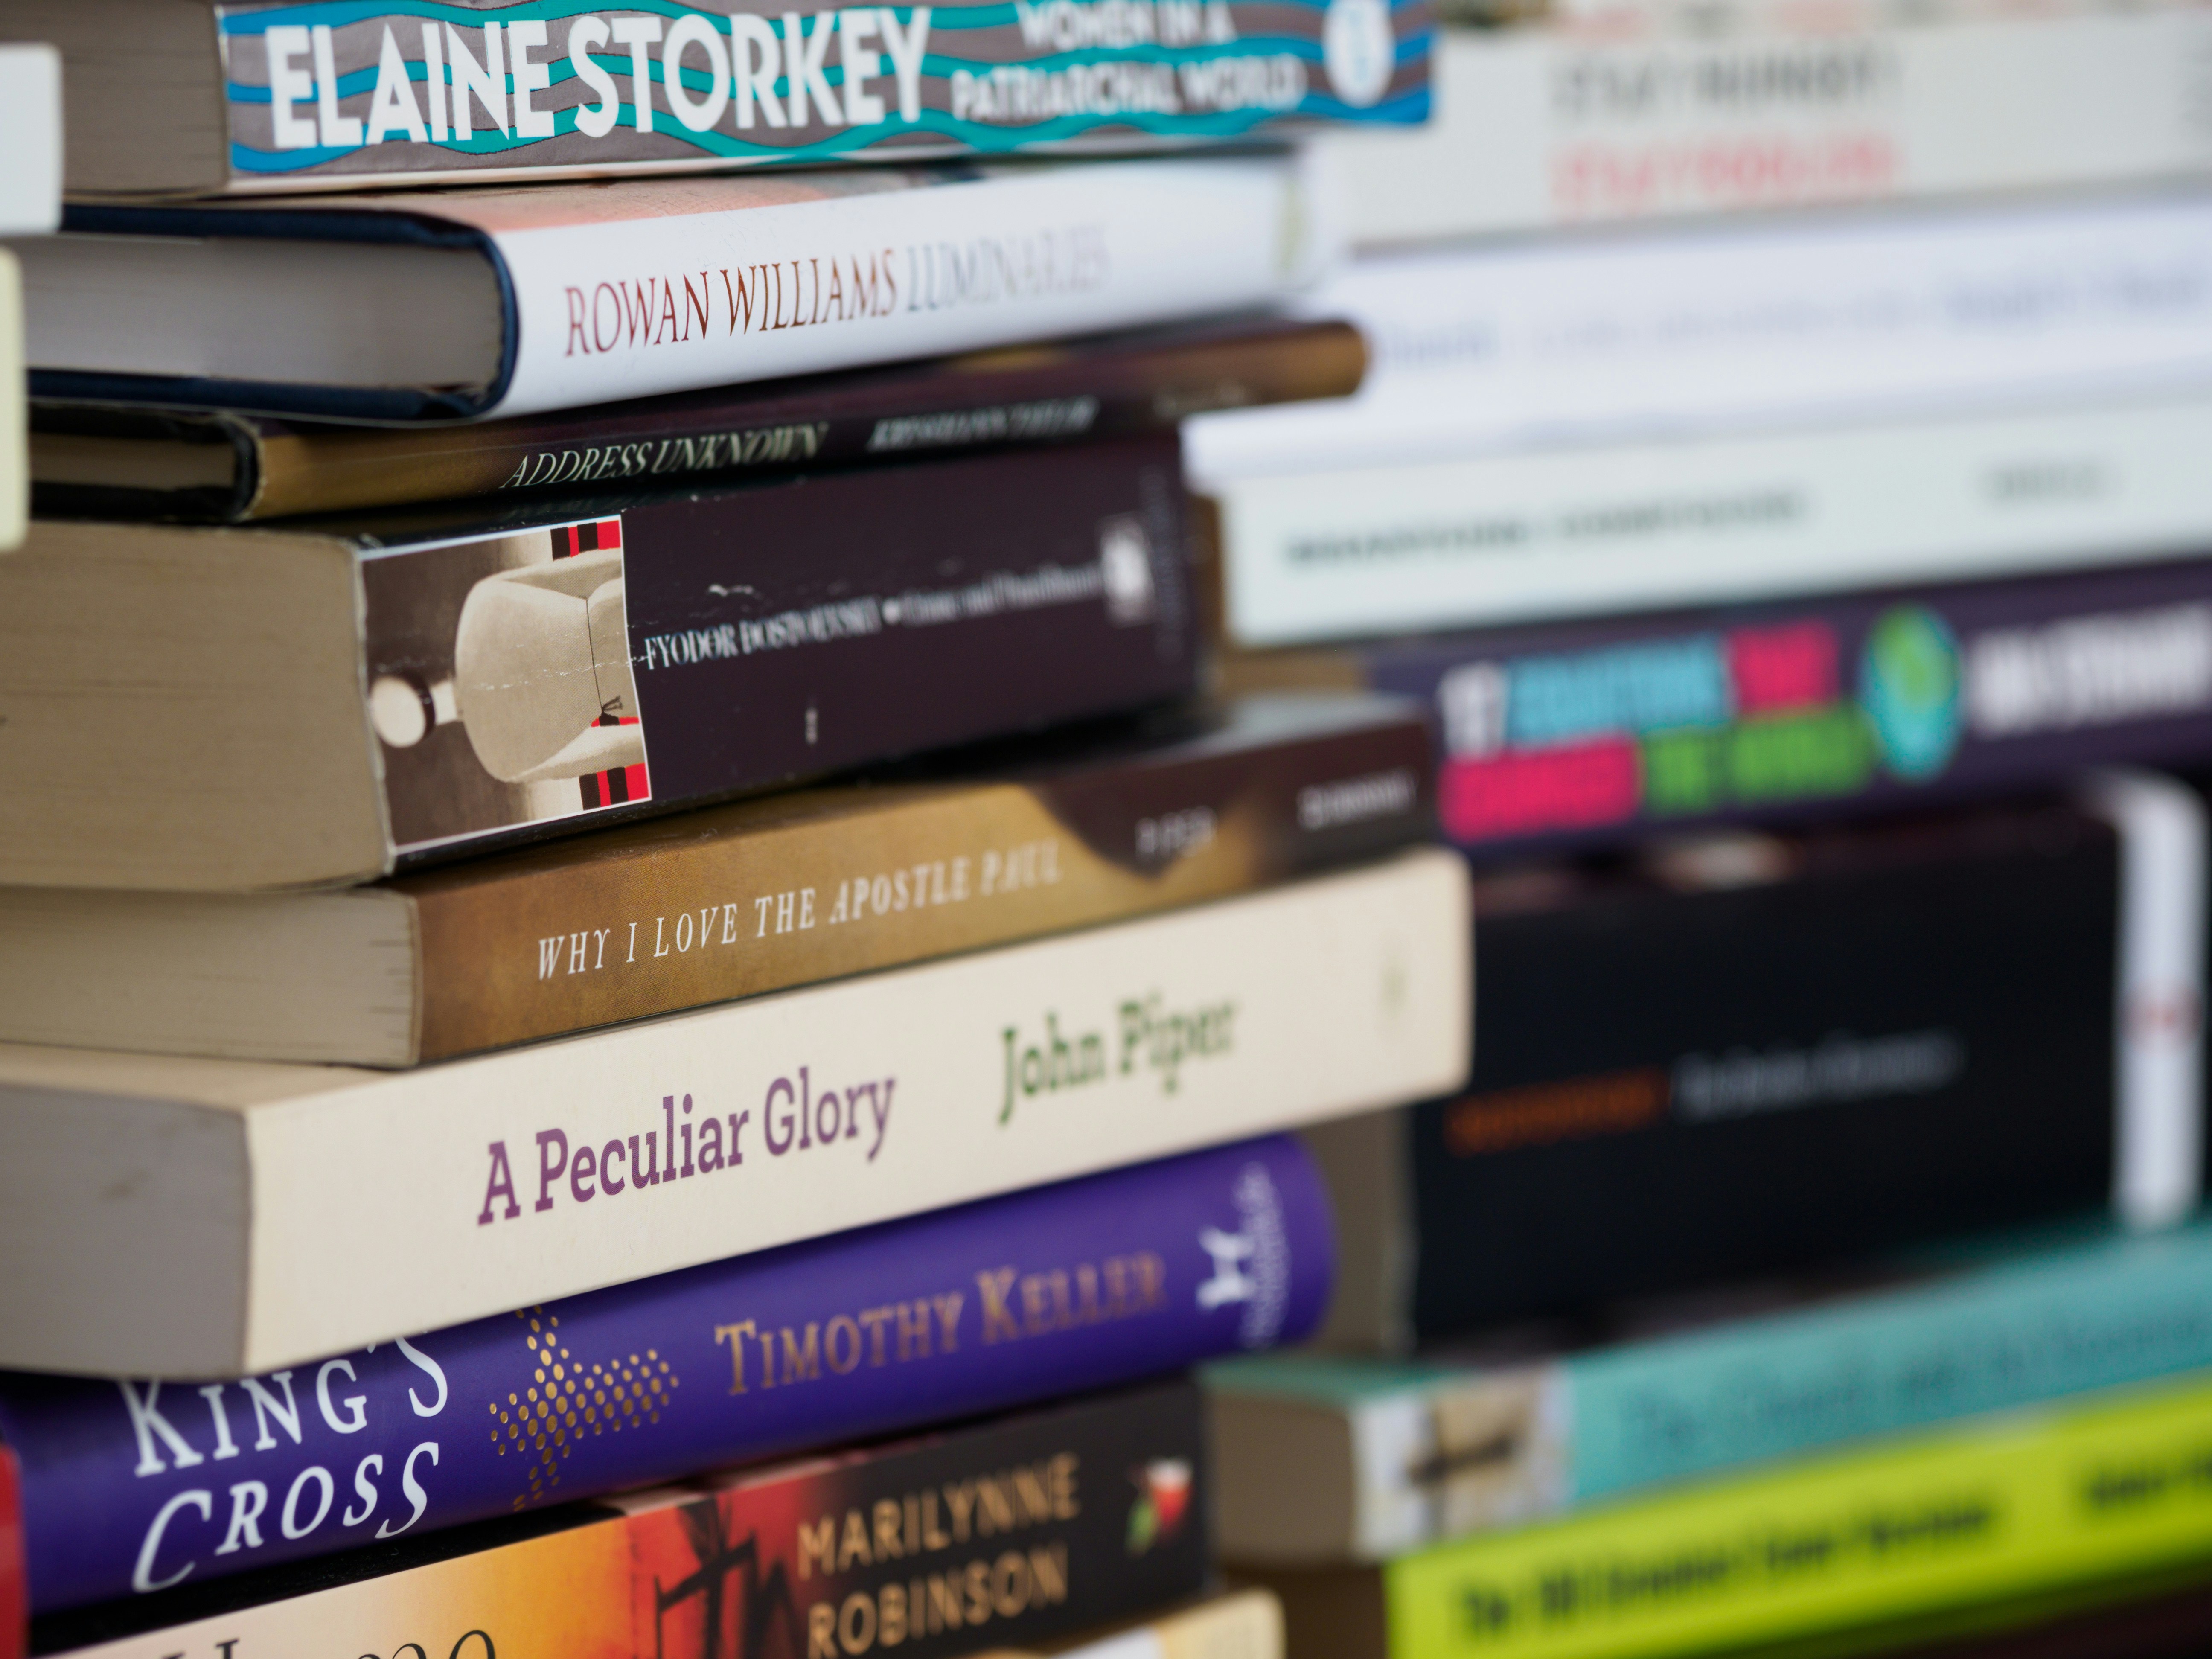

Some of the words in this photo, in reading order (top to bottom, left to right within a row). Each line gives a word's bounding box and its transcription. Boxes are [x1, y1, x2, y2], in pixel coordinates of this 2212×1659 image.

[265, 20, 555, 149] ELAINE
[568, 6, 932, 139] STORKEY
[951, 60, 1180, 122] PATRIARCHAL
[1180, 52, 1308, 114] WORLD
[1015, 0, 1156, 52] WOMEN
[564, 271, 709, 358] ROWAN
[719, 249, 897, 336] WILLIAMS
[498, 440, 653, 489] ADDRESS
[651, 420, 830, 474] UNKNOWN
[644, 623, 739, 670] FYODOR
[538, 928, 611, 981] WHY
[626, 922, 638, 963] I
[653, 903, 738, 957] LOVE
[755, 887, 817, 938] THE
[828, 855, 972, 925] APOSTLE
[980, 836, 1062, 896] PAUL
[477, 1141, 521, 1227] A
[535, 1093, 750, 1212] Peculiar
[763, 1066, 896, 1163] Glory
[997, 1017, 1108, 1126] John
[1119, 992, 1240, 1096] Piper
[714, 1291, 965, 1396] TIMOTHY
[975, 1249, 1170, 1345] KELLER
[116, 1336, 448, 1478] KING'S
[131, 1441, 439, 1594] CROSS
[796, 1452, 1081, 1581] MARILYNNE
[807, 1539, 1068, 1659] ROBINSON
